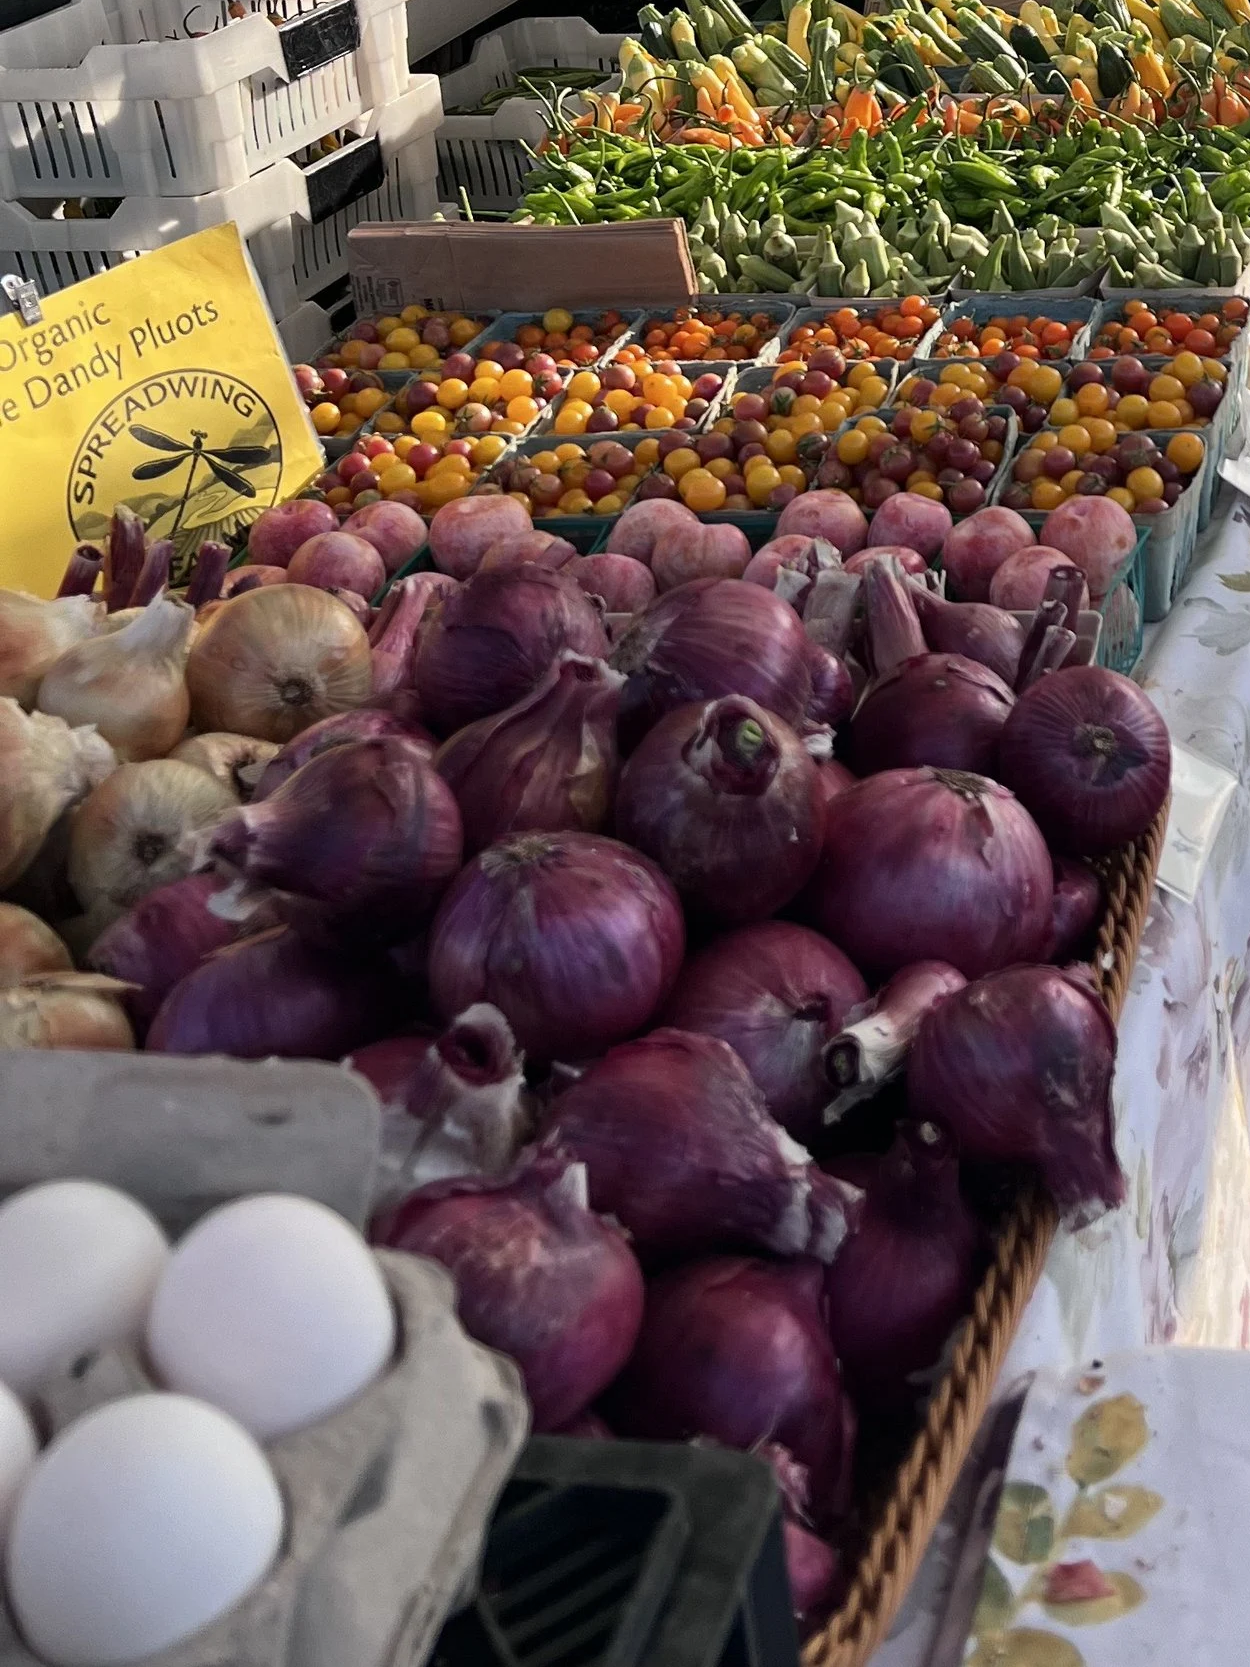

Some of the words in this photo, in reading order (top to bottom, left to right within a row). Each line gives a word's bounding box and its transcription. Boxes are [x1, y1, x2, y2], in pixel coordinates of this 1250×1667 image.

[24, 342, 123, 411] Dandy
[128, 300, 219, 358] Pluots
[74, 375, 257, 506] SPREADWING
